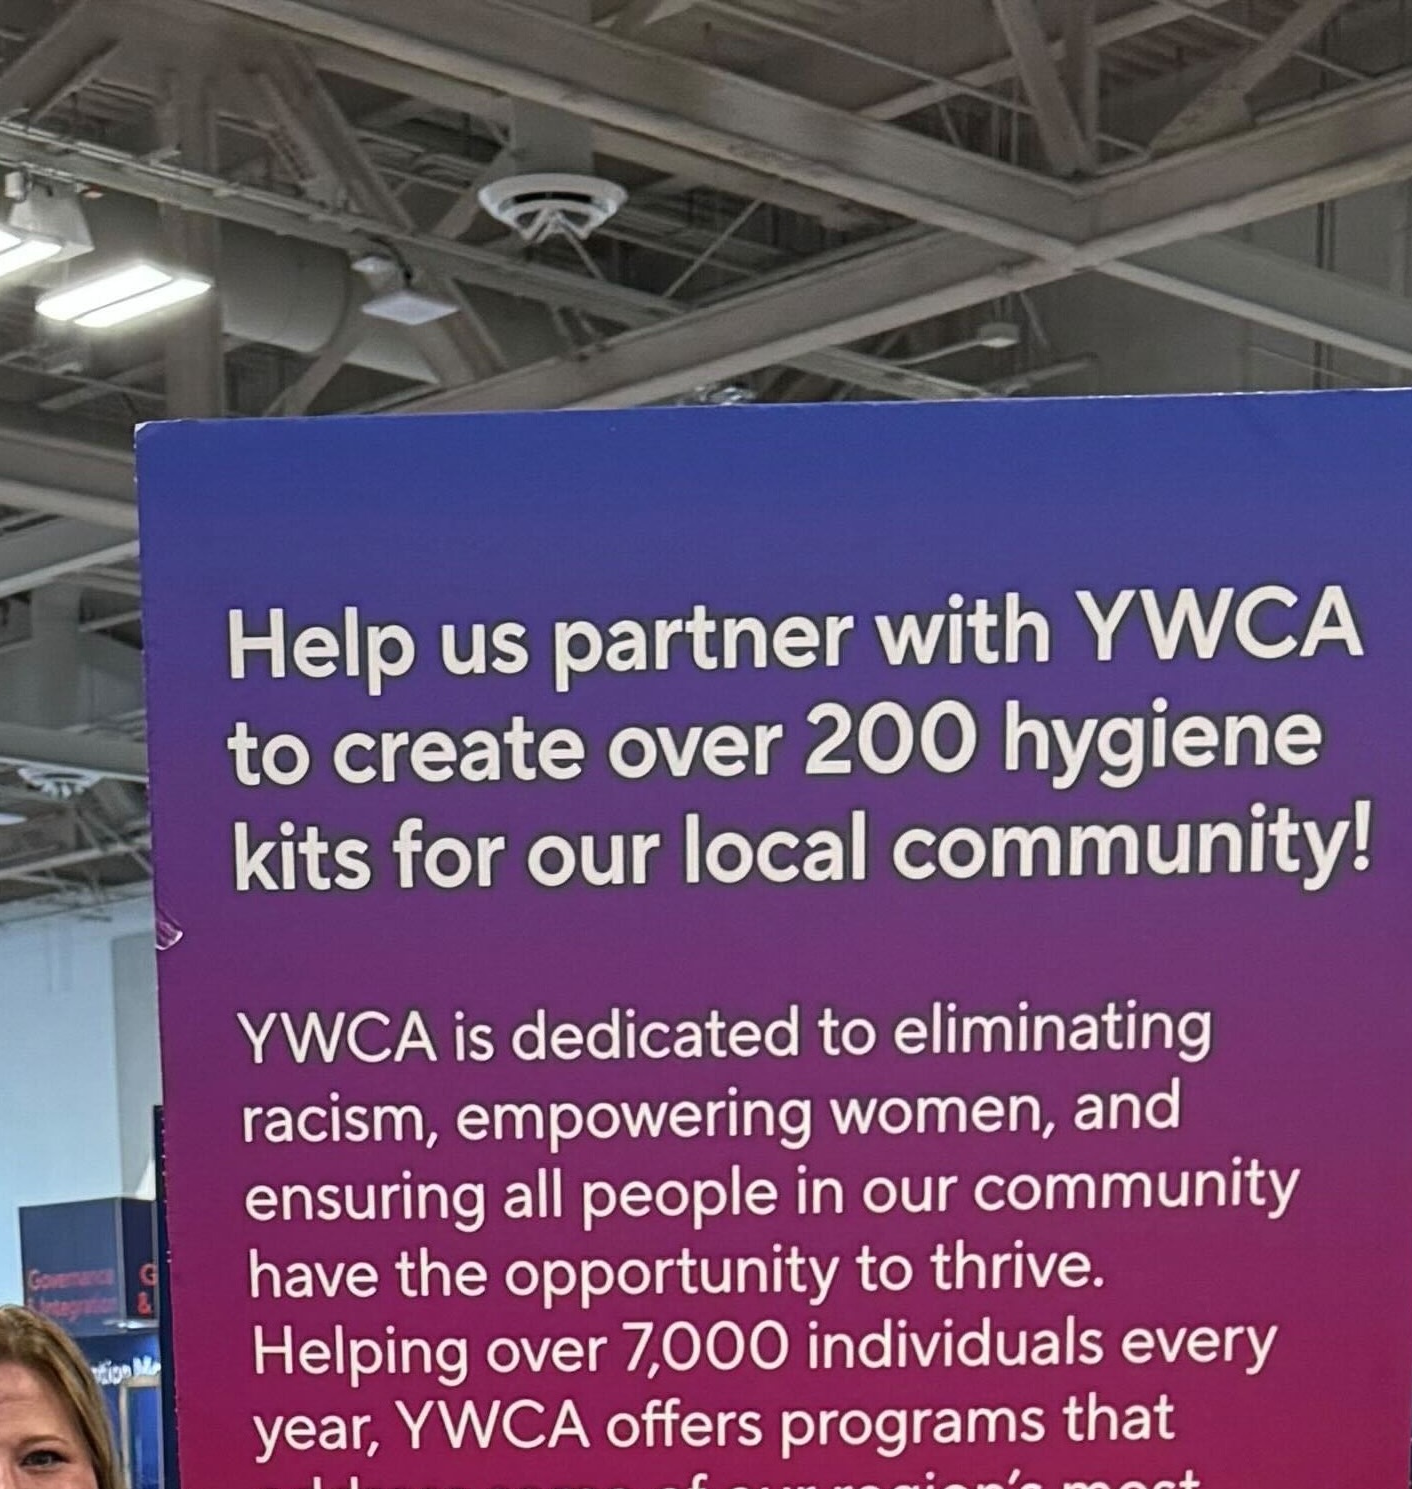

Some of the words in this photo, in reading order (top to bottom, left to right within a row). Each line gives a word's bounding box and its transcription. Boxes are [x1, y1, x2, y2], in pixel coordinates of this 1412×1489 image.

[229, 606, 415, 697] Help
[441, 622, 529, 675] us
[554, 604, 855, 693] partner
[874, 591, 1050, 666] with
[1075, 585, 1364, 661] YWCA
[227, 721, 310, 786] to
[333, 715, 585, 784] create
[608, 723, 784, 779] over
[805, 699, 977, 775] 200
[1005, 696, 1323, 790] hygiene
[234, 821, 371, 891] kits
[392, 817, 506, 889] for
[527, 833, 661, 887] our
[685, 809, 866, 884] local
[892, 799, 1371, 891] community!
[236, 1010, 438, 1064] YWCA
[454, 1010, 495, 1062] is
[512, 1004, 799, 1061] dedicated
[817, 1007, 877, 1056] to
[894, 999, 1211, 1063] eliminating
[243, 1091, 438, 1149] racism,
[456, 1086, 811, 1154] empowering
[829, 1094, 1055, 1139] women,
[1074, 1076, 1180, 1131] and
[245, 1170, 485, 1233] ensuring
[504, 1167, 562, 1219] all
[583, 1164, 778, 1232] people
[797, 1164, 843, 1214] in
[863, 1175, 958, 1214] our
[974, 1156, 1301, 1220] community
[249, 1248, 379, 1298] have
[394, 1246, 488, 1298] the
[505, 1243, 840, 1310] opportunity
[855, 1245, 913, 1292] to
[929, 1239, 1104, 1291] thrive.
[254, 1324, 468, 1388] Helping
[487, 1336, 608, 1373] over
[622, 1319, 789, 1379] 7,000
[808, 1315, 1104, 1369] individuals
[1121, 1325, 1278, 1375] every
[253, 1415, 379, 1464] year,
[394, 1398, 591, 1449] YWCA
[606, 1397, 763, 1448] offers
[781, 1406, 1046, 1460] programs
[1062, 1391, 1175, 1442] that
